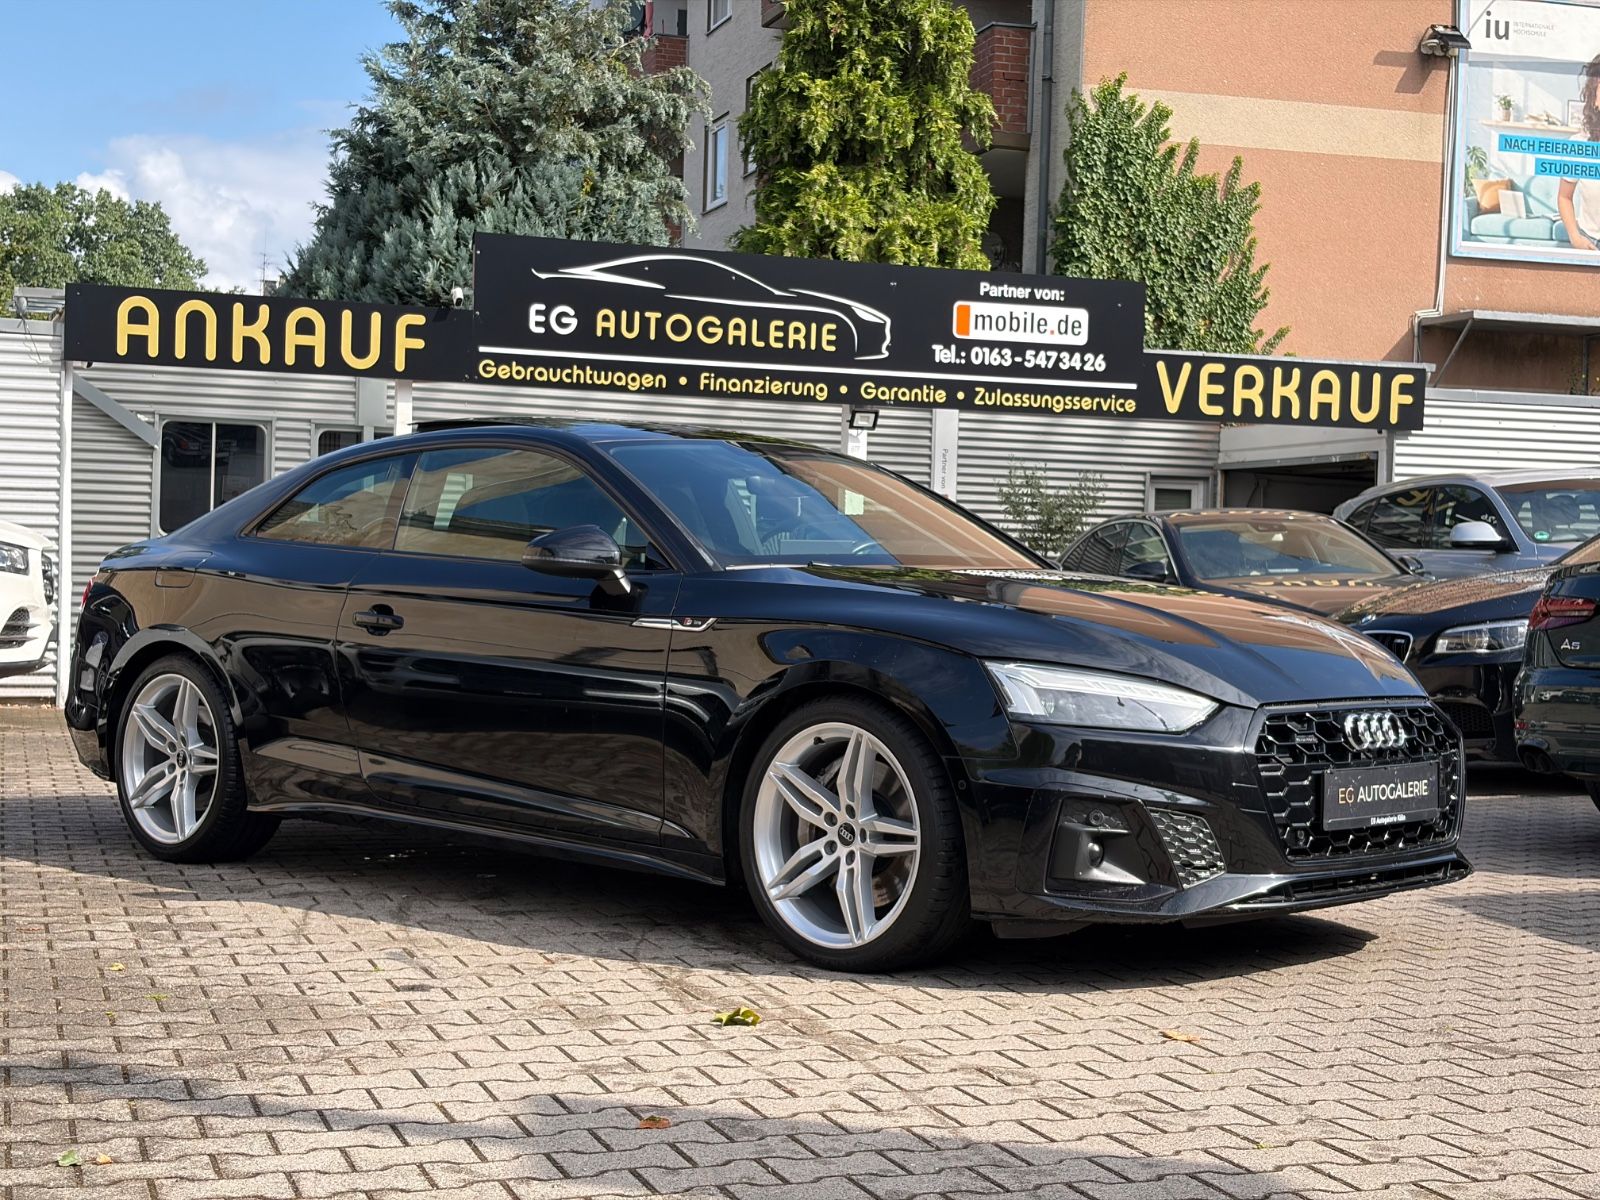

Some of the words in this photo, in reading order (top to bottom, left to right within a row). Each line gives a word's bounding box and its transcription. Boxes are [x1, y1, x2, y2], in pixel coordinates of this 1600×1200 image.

[1485, 10, 1510, 40] iu
[1504, 138, 1536, 152] NACH
[1540, 162, 1600, 178] STUDIEREN
[980, 281, 1032, 299] Partner
[1034, 288, 1065, 301] von:
[116, 295, 426, 372] ANKAUF
[528, 303, 578, 335] EG
[596, 308, 838, 352] AUTOGALERIE
[974, 311, 1082, 336] mobile.de
[931, 344, 966, 364] Tel.:
[478, 359, 667, 391] Gebrauchtwagen
[700, 372, 828, 401] Finanzierung
[860, 381, 946, 403] Garantie
[974, 386, 1137, 413] Zulassungsservice
[1156, 360, 1415, 425] VERKAUF
[1560, 638, 1580, 650] A5
[1338, 787, 1355, 804] EG
[1357, 780, 1429, 803] AUTOGALERIE
